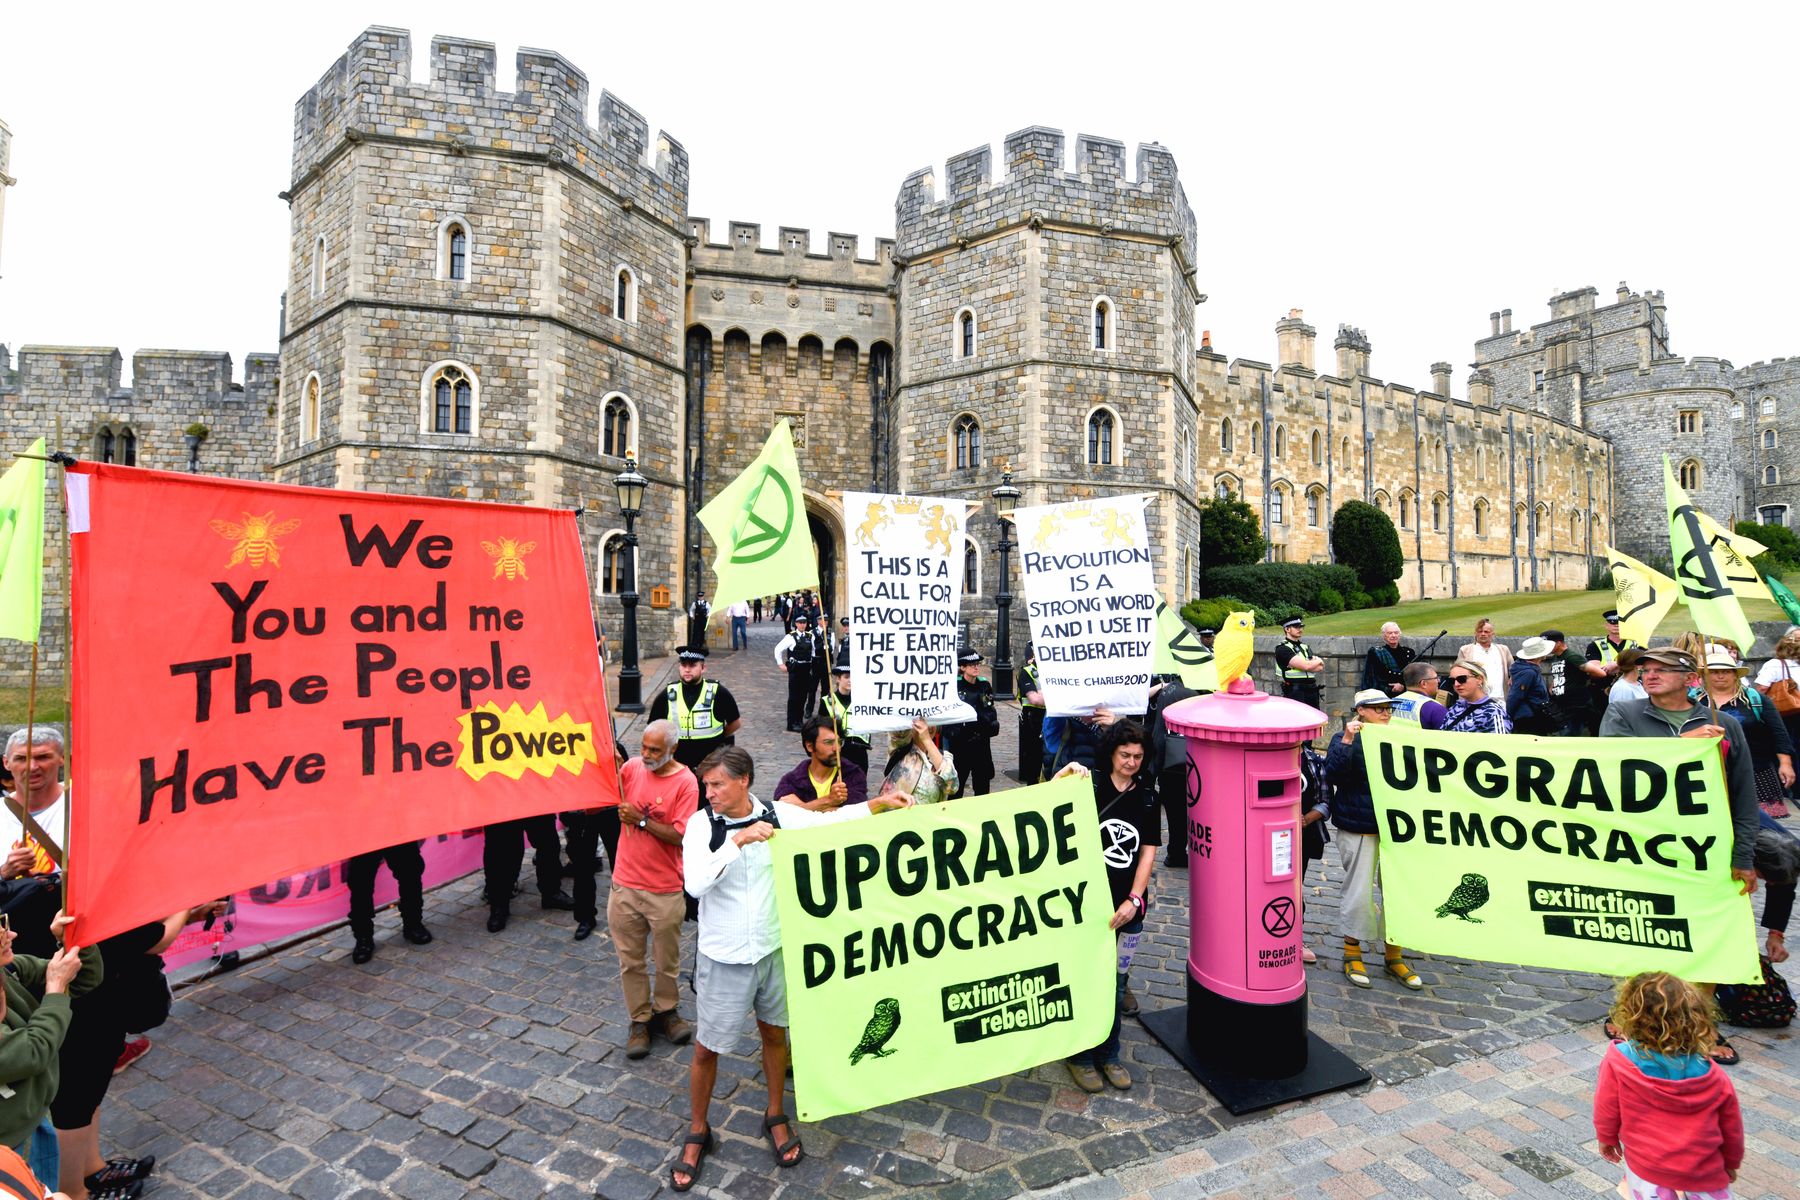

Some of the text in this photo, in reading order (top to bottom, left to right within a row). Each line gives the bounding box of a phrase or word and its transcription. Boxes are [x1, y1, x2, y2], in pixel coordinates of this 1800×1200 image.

[339, 513, 453, 568] We
[861, 551, 948, 578] THIS IS A
[1024, 548, 1150, 574] REVOLUTION
[861, 581, 951, 603] CALL FOR
[1070, 574, 1114, 592] IS A
[212, 580, 524, 643] You and me
[853, 606, 957, 627] REVOLUTION
[1029, 594, 1155, 617] STRONG WORD
[1041, 617, 1152, 638] AND I USE IT
[856, 633, 895, 651] THE
[906, 632, 956, 651] EARTH
[1038, 641, 1151, 662] DELIBERATELY
[865, 653, 952, 675] IS UNDER
[170, 641, 531, 722] The People
[874, 681, 949, 701] THREAT
[1045, 674, 1148, 686] PRINCE CHARLES 2010
[854, 705, 893, 716] PRINCE
[898, 705, 942, 717] CHARLES
[138, 711, 585, 824] Have The Power
[1379, 742, 1710, 816] UPGRADE
[1386, 809, 1717, 871] DEMOCRACY
[794, 802, 1079, 918] UPGRADE
[1534, 886, 1654, 917] extinction
[802, 881, 1088, 989] DEMOCRACY
[1573, 911, 1685, 948] rebellion
[1259, 945, 1296, 959] UPGRADE
[1259, 956, 1296, 968] DEMOCRACY
[947, 973, 1046, 1012] extinction
[980, 995, 1070, 1035] rebellion
